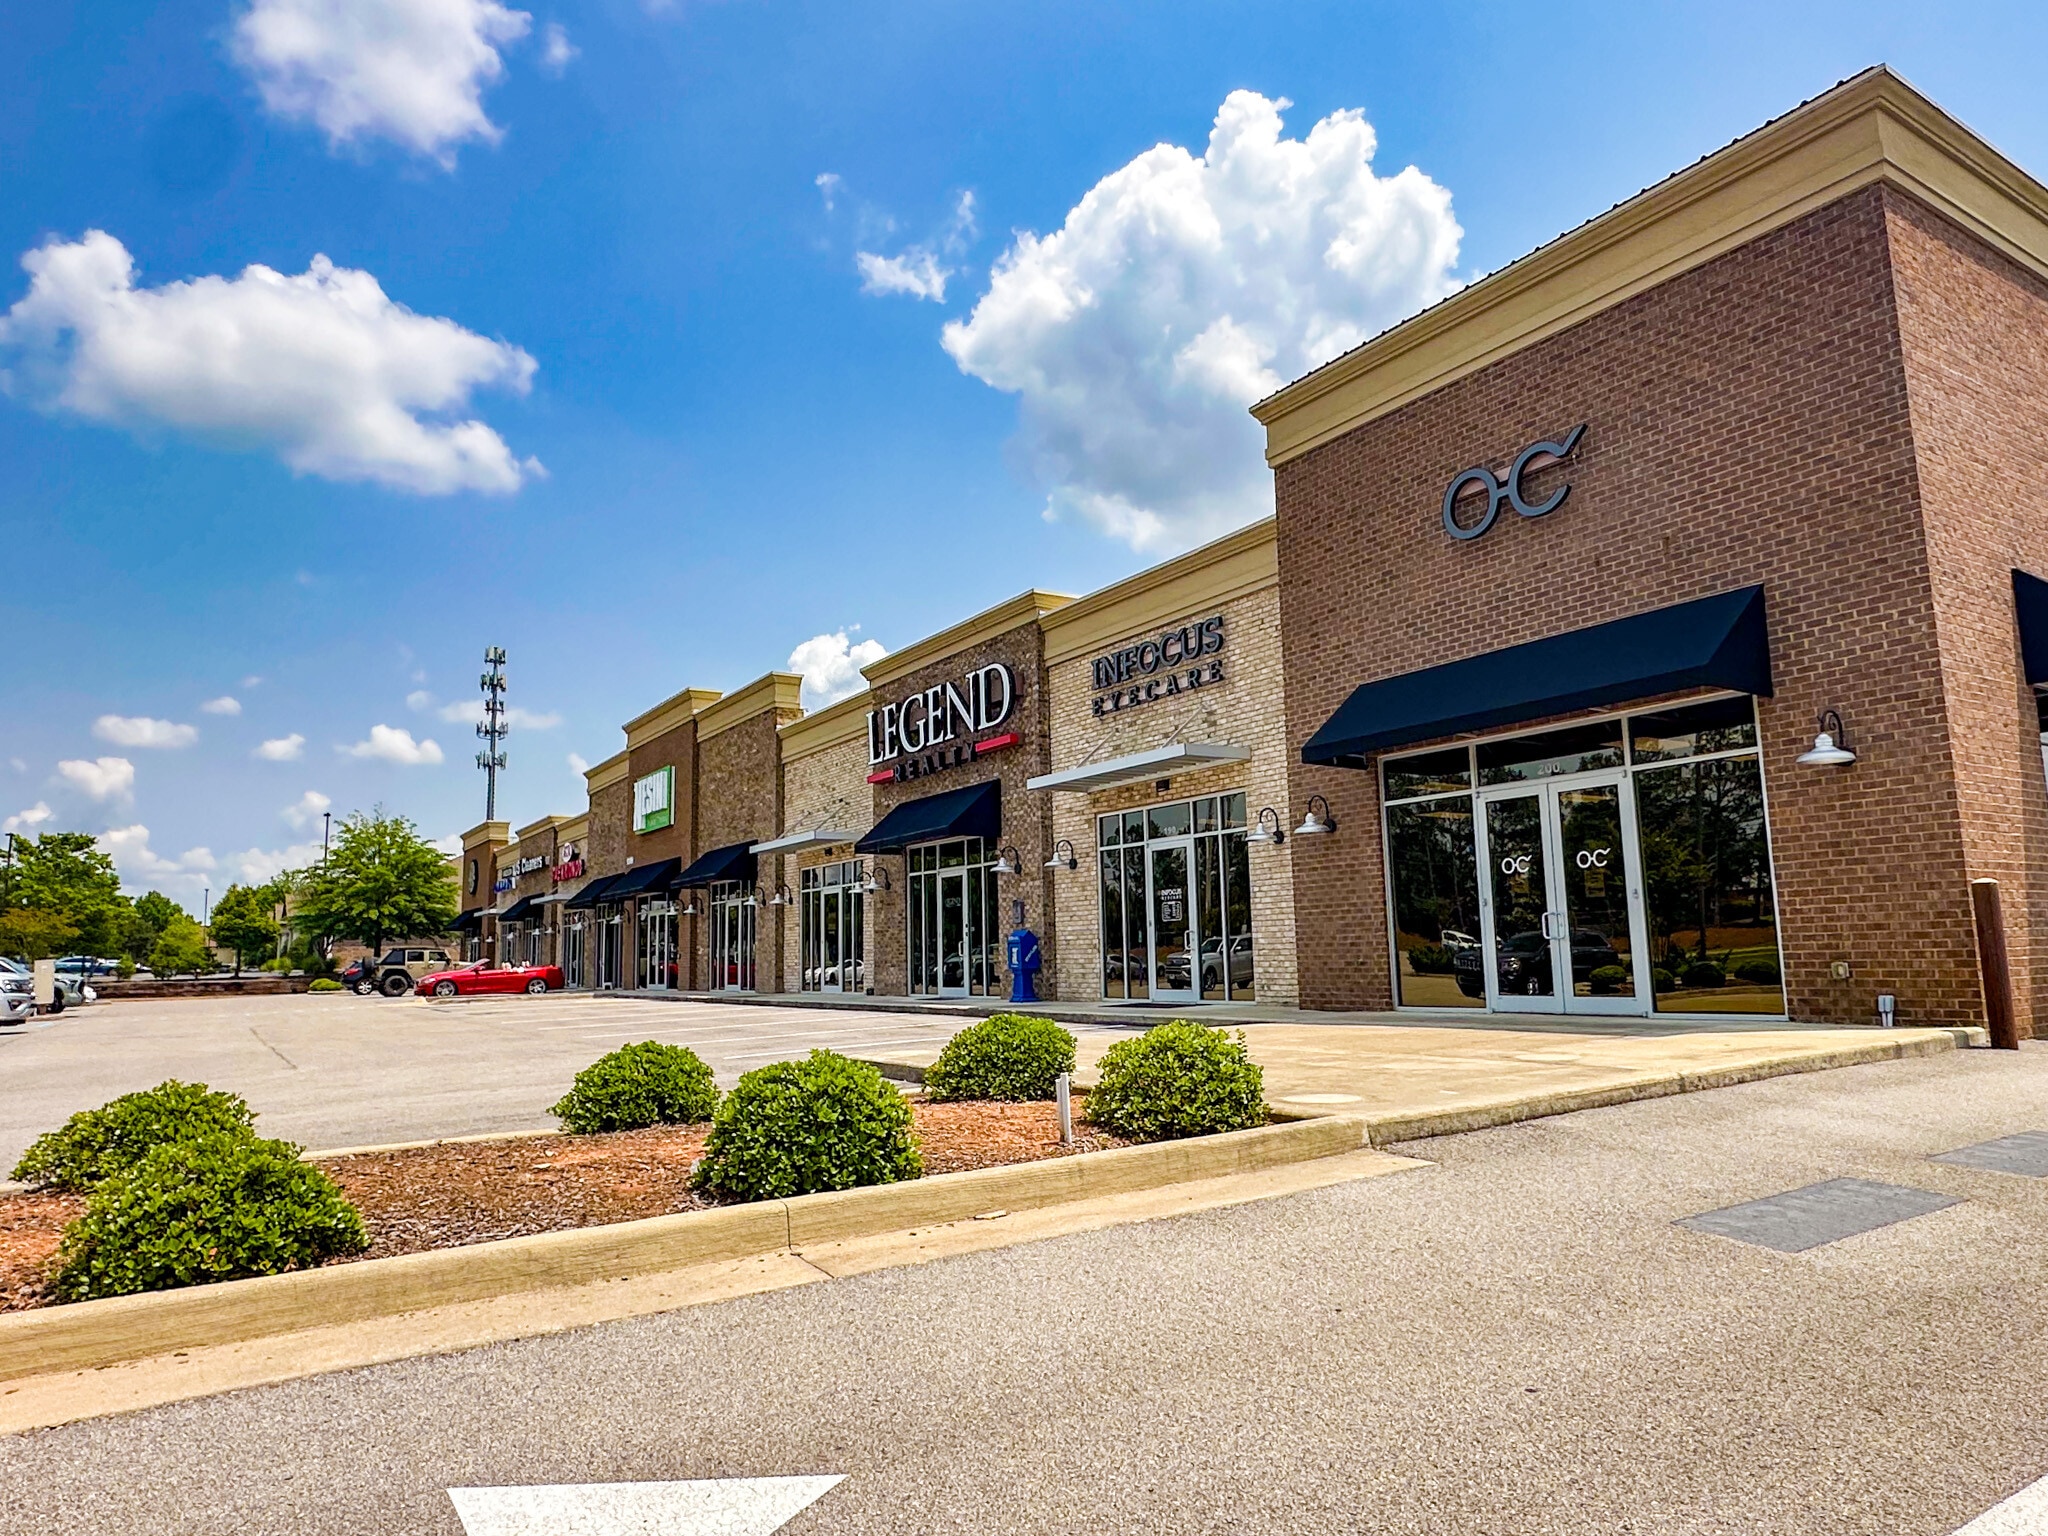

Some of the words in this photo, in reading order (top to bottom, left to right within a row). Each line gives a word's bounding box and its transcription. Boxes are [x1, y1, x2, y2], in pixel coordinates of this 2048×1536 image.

[1091, 615, 1223, 690] INFOCUS
[866, 662, 1015, 766] LEGEND
[1092, 660, 1224, 717] EYECARE
[894, 741, 978, 783] REALTY
[1536, 762, 1560, 775] 200
